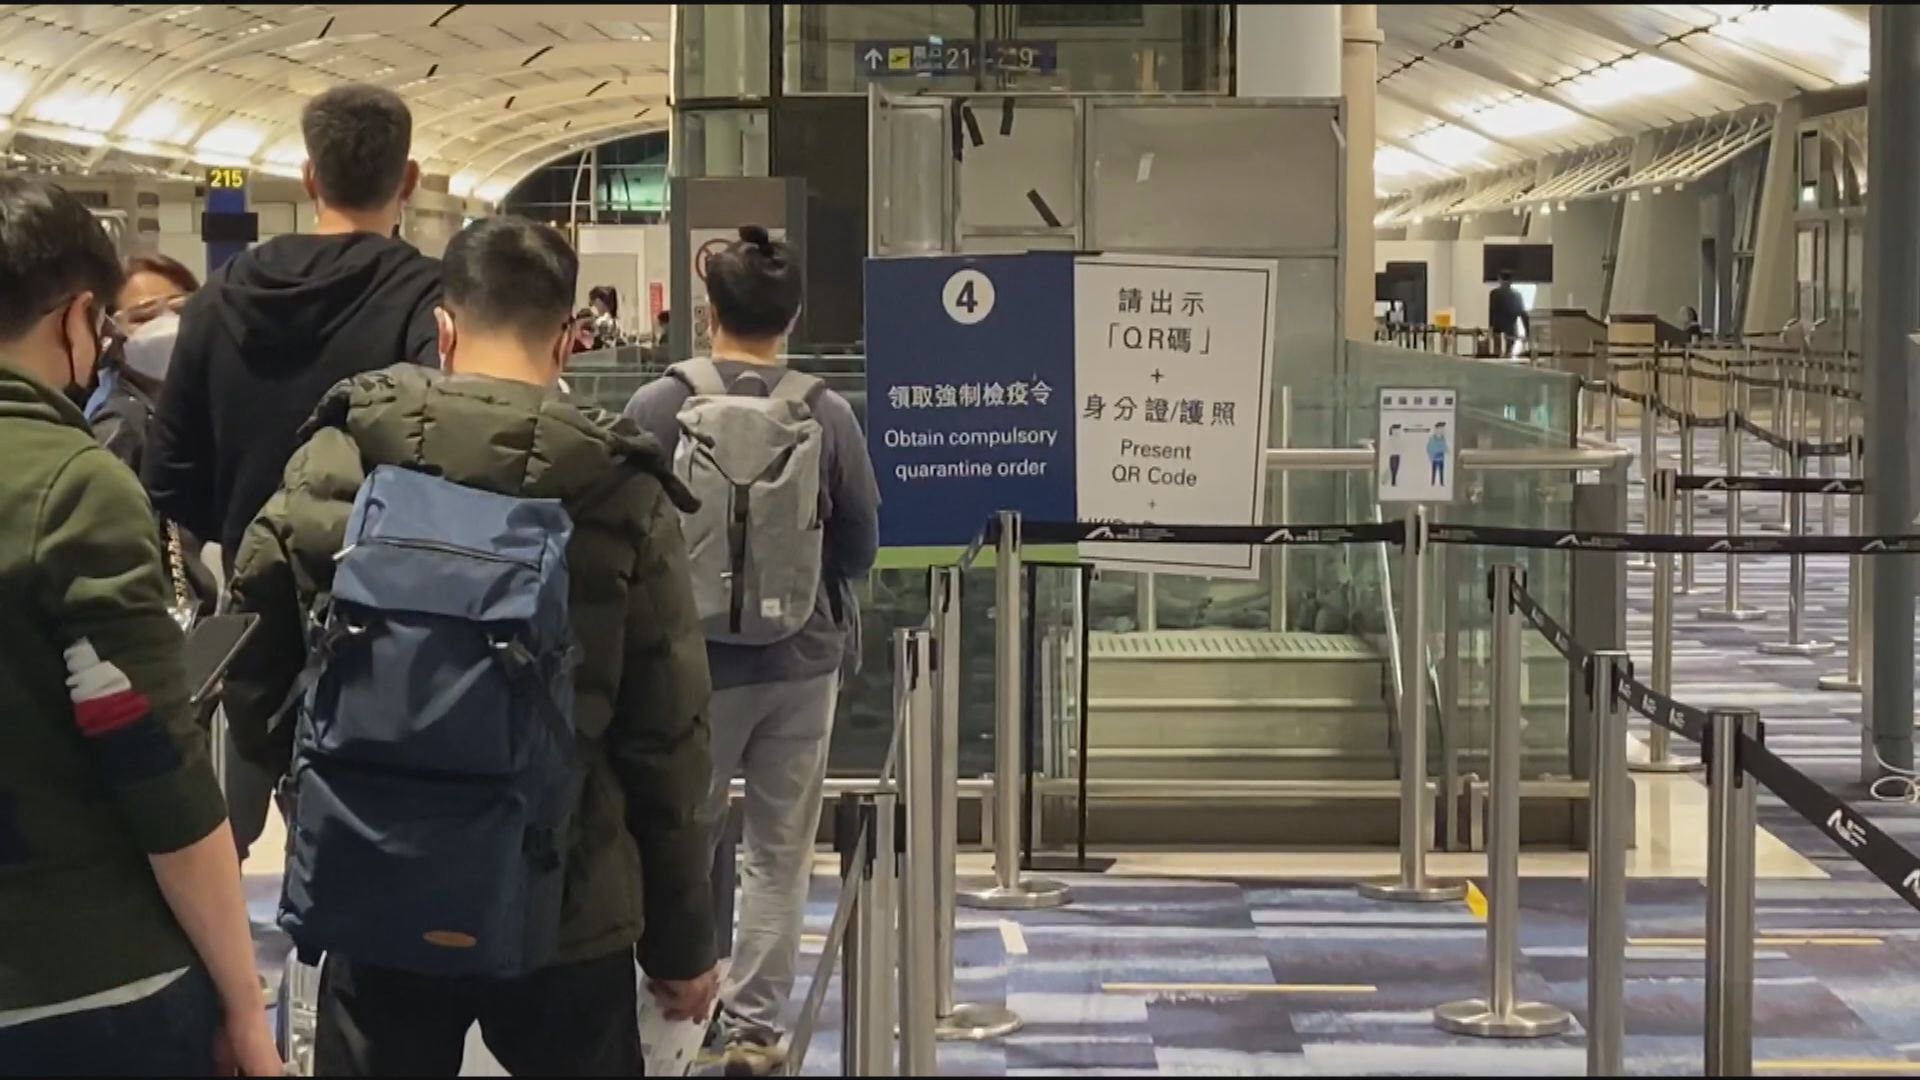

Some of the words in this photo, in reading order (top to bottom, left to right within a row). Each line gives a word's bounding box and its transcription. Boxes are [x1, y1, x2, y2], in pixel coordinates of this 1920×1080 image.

[210, 169, 243, 187] 215
[955, 280, 979, 313] 4
[1118, 287, 1204, 317] 請出示
[884, 428, 944, 447] Obtain
[949, 426, 1058, 448] compulsory
[1121, 438, 1192, 460] Present
[895, 460, 992, 482] quarantine
[997, 458, 1048, 476] order
[1112, 464, 1140, 483] QR
[1148, 466, 1197, 487] Code
